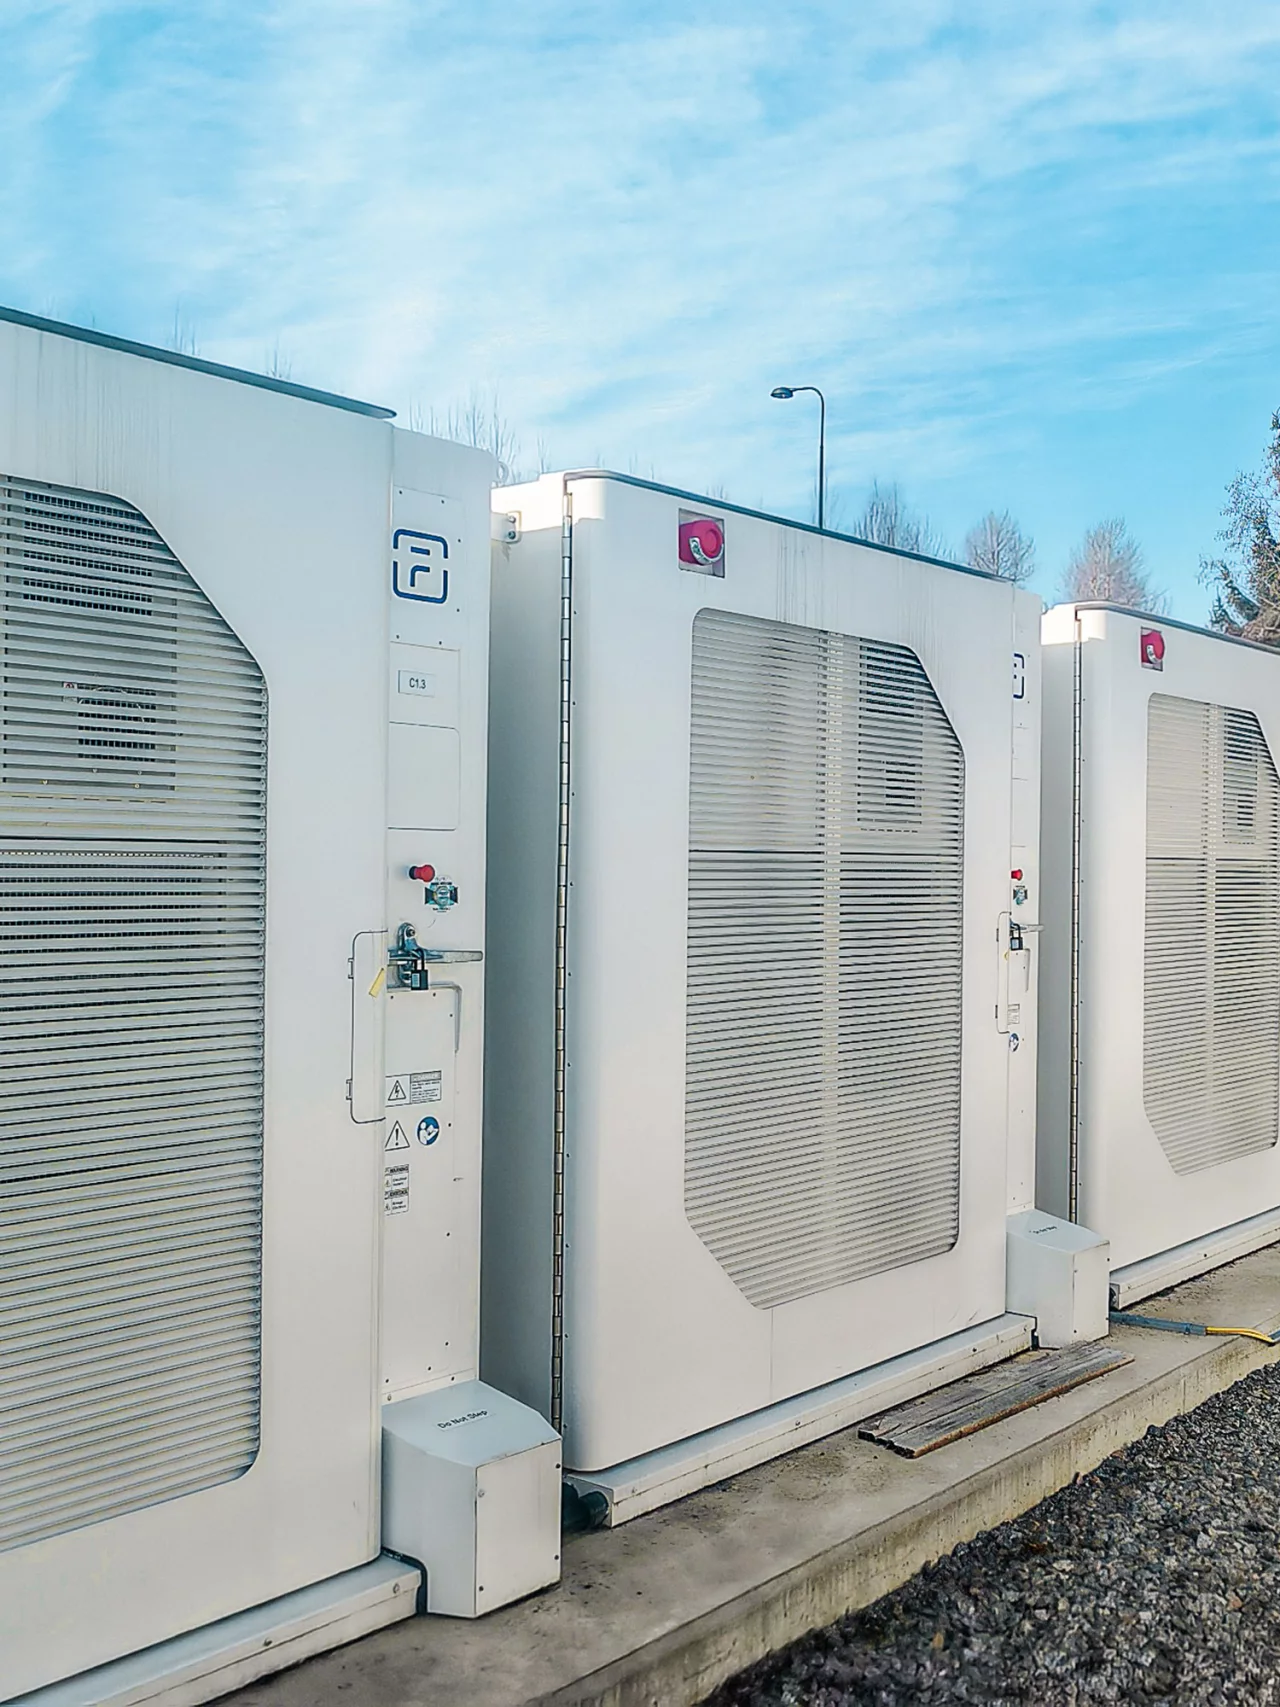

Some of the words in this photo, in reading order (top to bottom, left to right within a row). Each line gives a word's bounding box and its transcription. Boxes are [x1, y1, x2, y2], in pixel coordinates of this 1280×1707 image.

[409, 677, 427, 689] C1.3
[436, 1421, 452, 1429] Do
[450, 1416, 469, 1425] Not
[466, 1410, 488, 1420] Step
